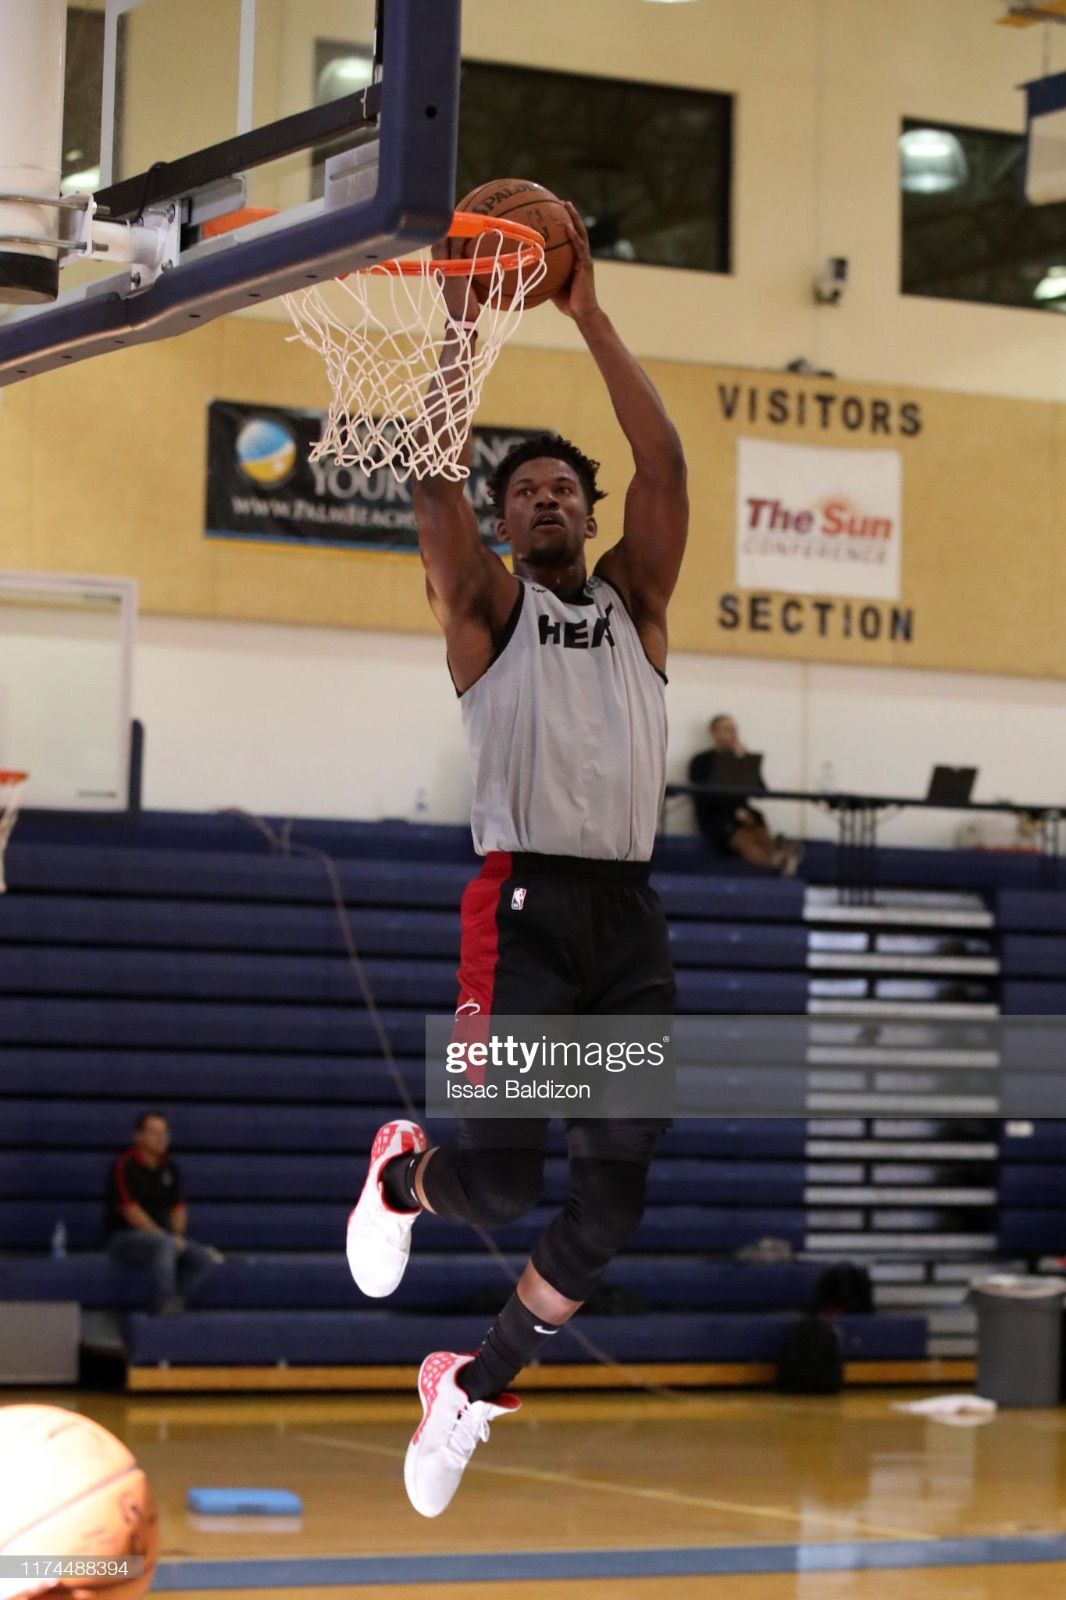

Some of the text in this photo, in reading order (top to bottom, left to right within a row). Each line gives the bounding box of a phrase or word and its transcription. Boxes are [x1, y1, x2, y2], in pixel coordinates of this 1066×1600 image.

[472, 183, 541, 216] SPALDI
[718, 382, 923, 437] VISITORS
[747, 497, 893, 540] The Sun
[718, 593, 914, 643] SECTION
